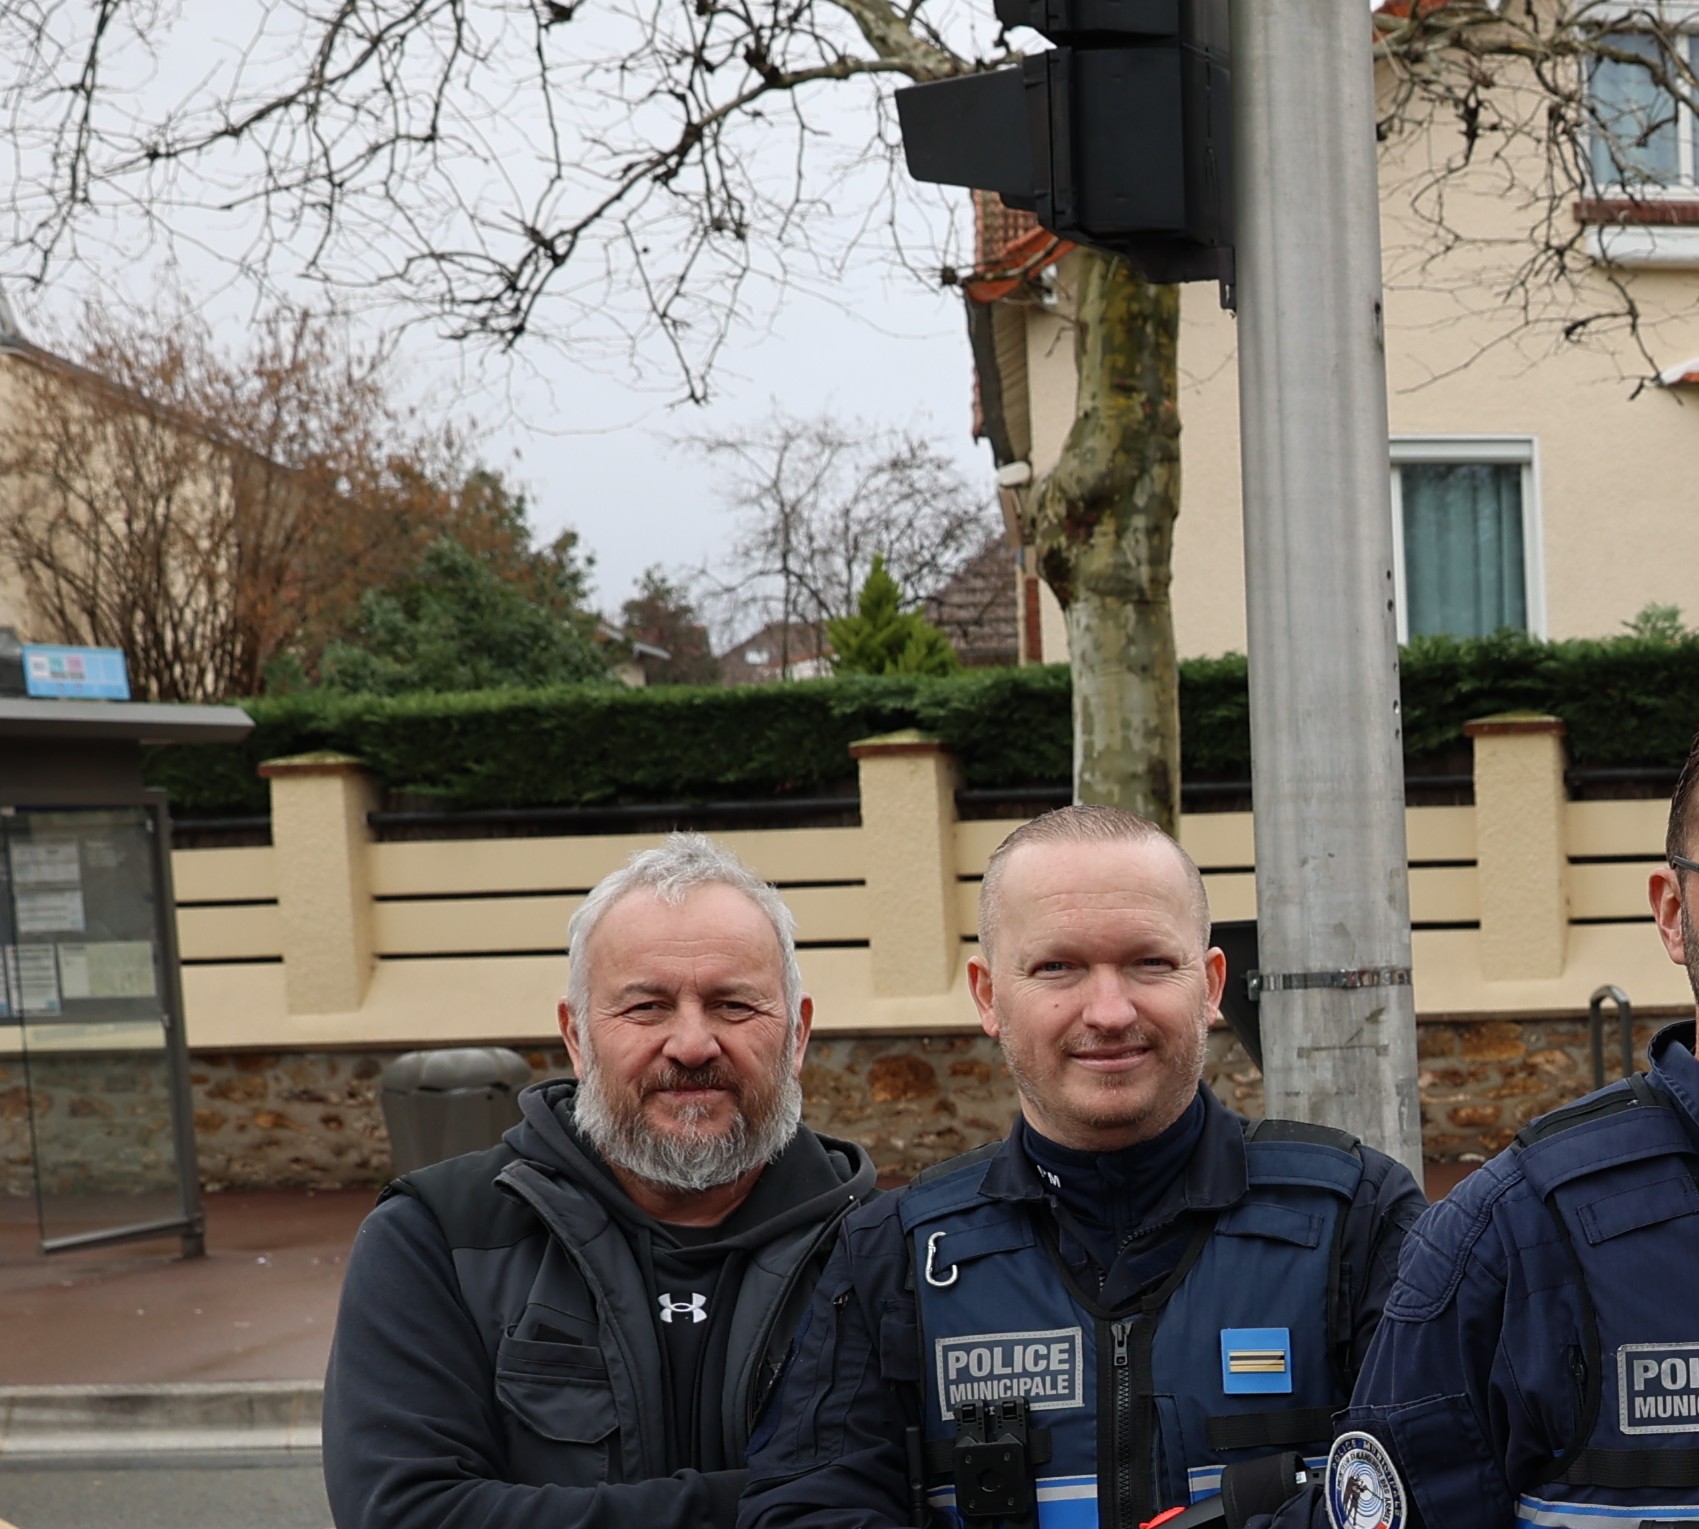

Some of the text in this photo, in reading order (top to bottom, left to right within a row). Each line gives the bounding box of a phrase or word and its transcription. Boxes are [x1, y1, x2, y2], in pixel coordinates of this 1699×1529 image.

[947, 1343, 1070, 1380] POLICE
[949, 1374, 1070, 1405] MUNICIPALE
[1332, 1439, 1358, 1469] POLICE
[1363, 1440, 1403, 1518] MUNICIPALE
